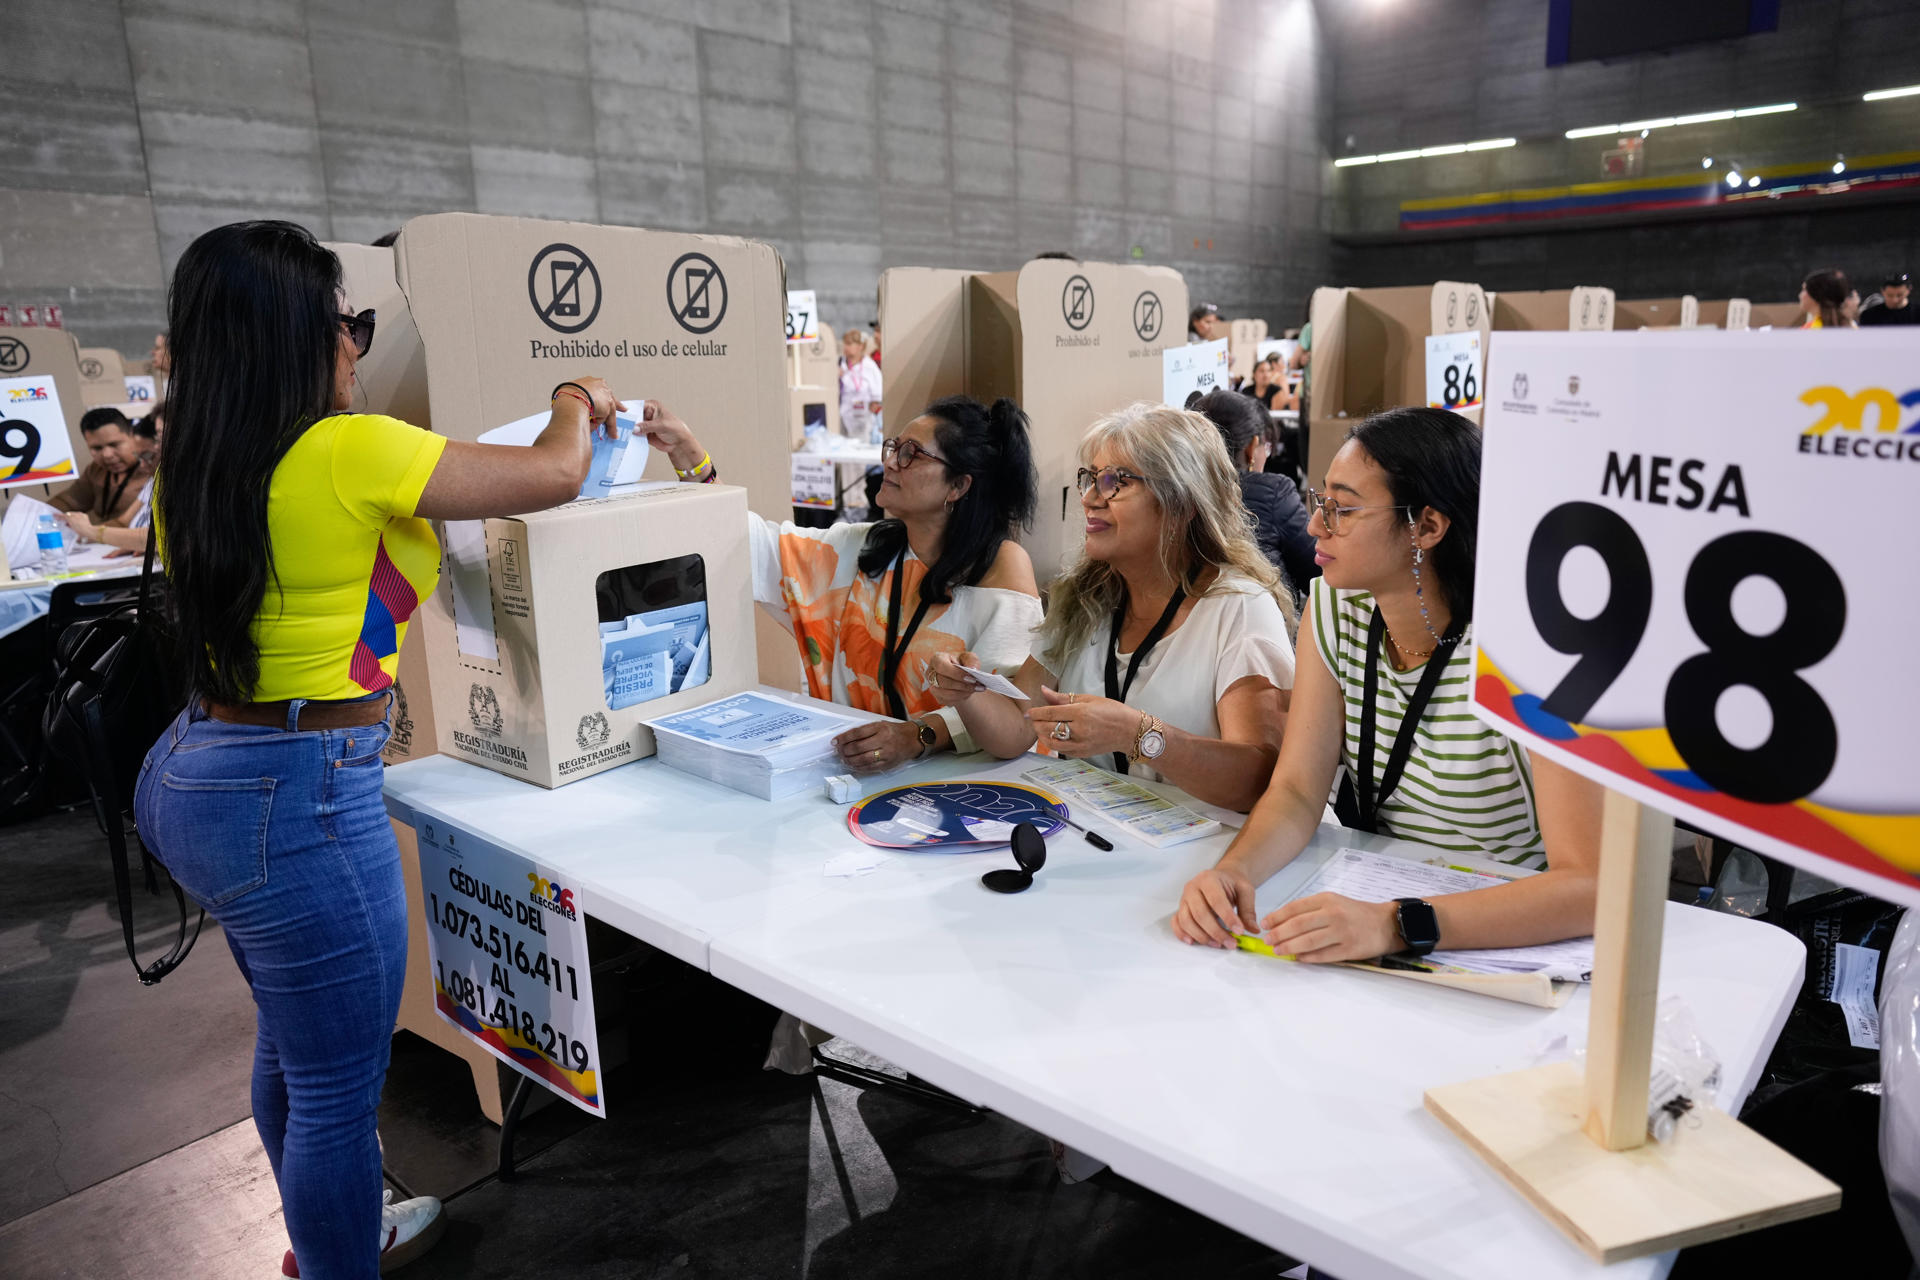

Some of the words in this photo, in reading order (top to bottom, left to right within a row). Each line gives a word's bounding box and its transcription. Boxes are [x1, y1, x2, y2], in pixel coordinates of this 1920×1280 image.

[530, 339, 610, 359] Prohibido
[614, 340, 628, 357] el
[632, 343, 657, 357] uso
[661, 340, 678, 357] de
[682, 340, 728, 356] celular
[1055, 335, 1092, 347] Prohibido
[1093, 335, 1100, 346] el
[8, 387, 47, 399] 2026
[1196, 372, 1215, 388] MESA
[1444, 363, 1476, 406] 86
[1601, 451, 1751, 518] MESA
[1526, 500, 1846, 804] 98
[664, 697, 750, 724] COLOMBIA
[454, 731, 527, 763] REGISTRADURÍA
[455, 742, 480, 755] NACIONAL
[481, 750, 491, 759] DEL
[492, 754, 512, 766] ESTADO
[514, 761, 528, 770] CIVIL
[558, 740, 631, 771] REGISTRADURÍA
[559, 766, 585, 776] NACIONAL
[598, 754, 618, 764] ESTADO
[618, 749, 631, 758] CIVIL
[449, 864, 513, 919] CÉDULAS
[517, 904, 546, 937] DEL
[527, 872, 576, 914] 2026
[529, 892, 577, 922] ELECCIONES
[430, 892, 579, 1001] 1.073.516.411
[490, 962, 515, 999] AL
[437, 959, 589, 1075] 1.081.418.219
